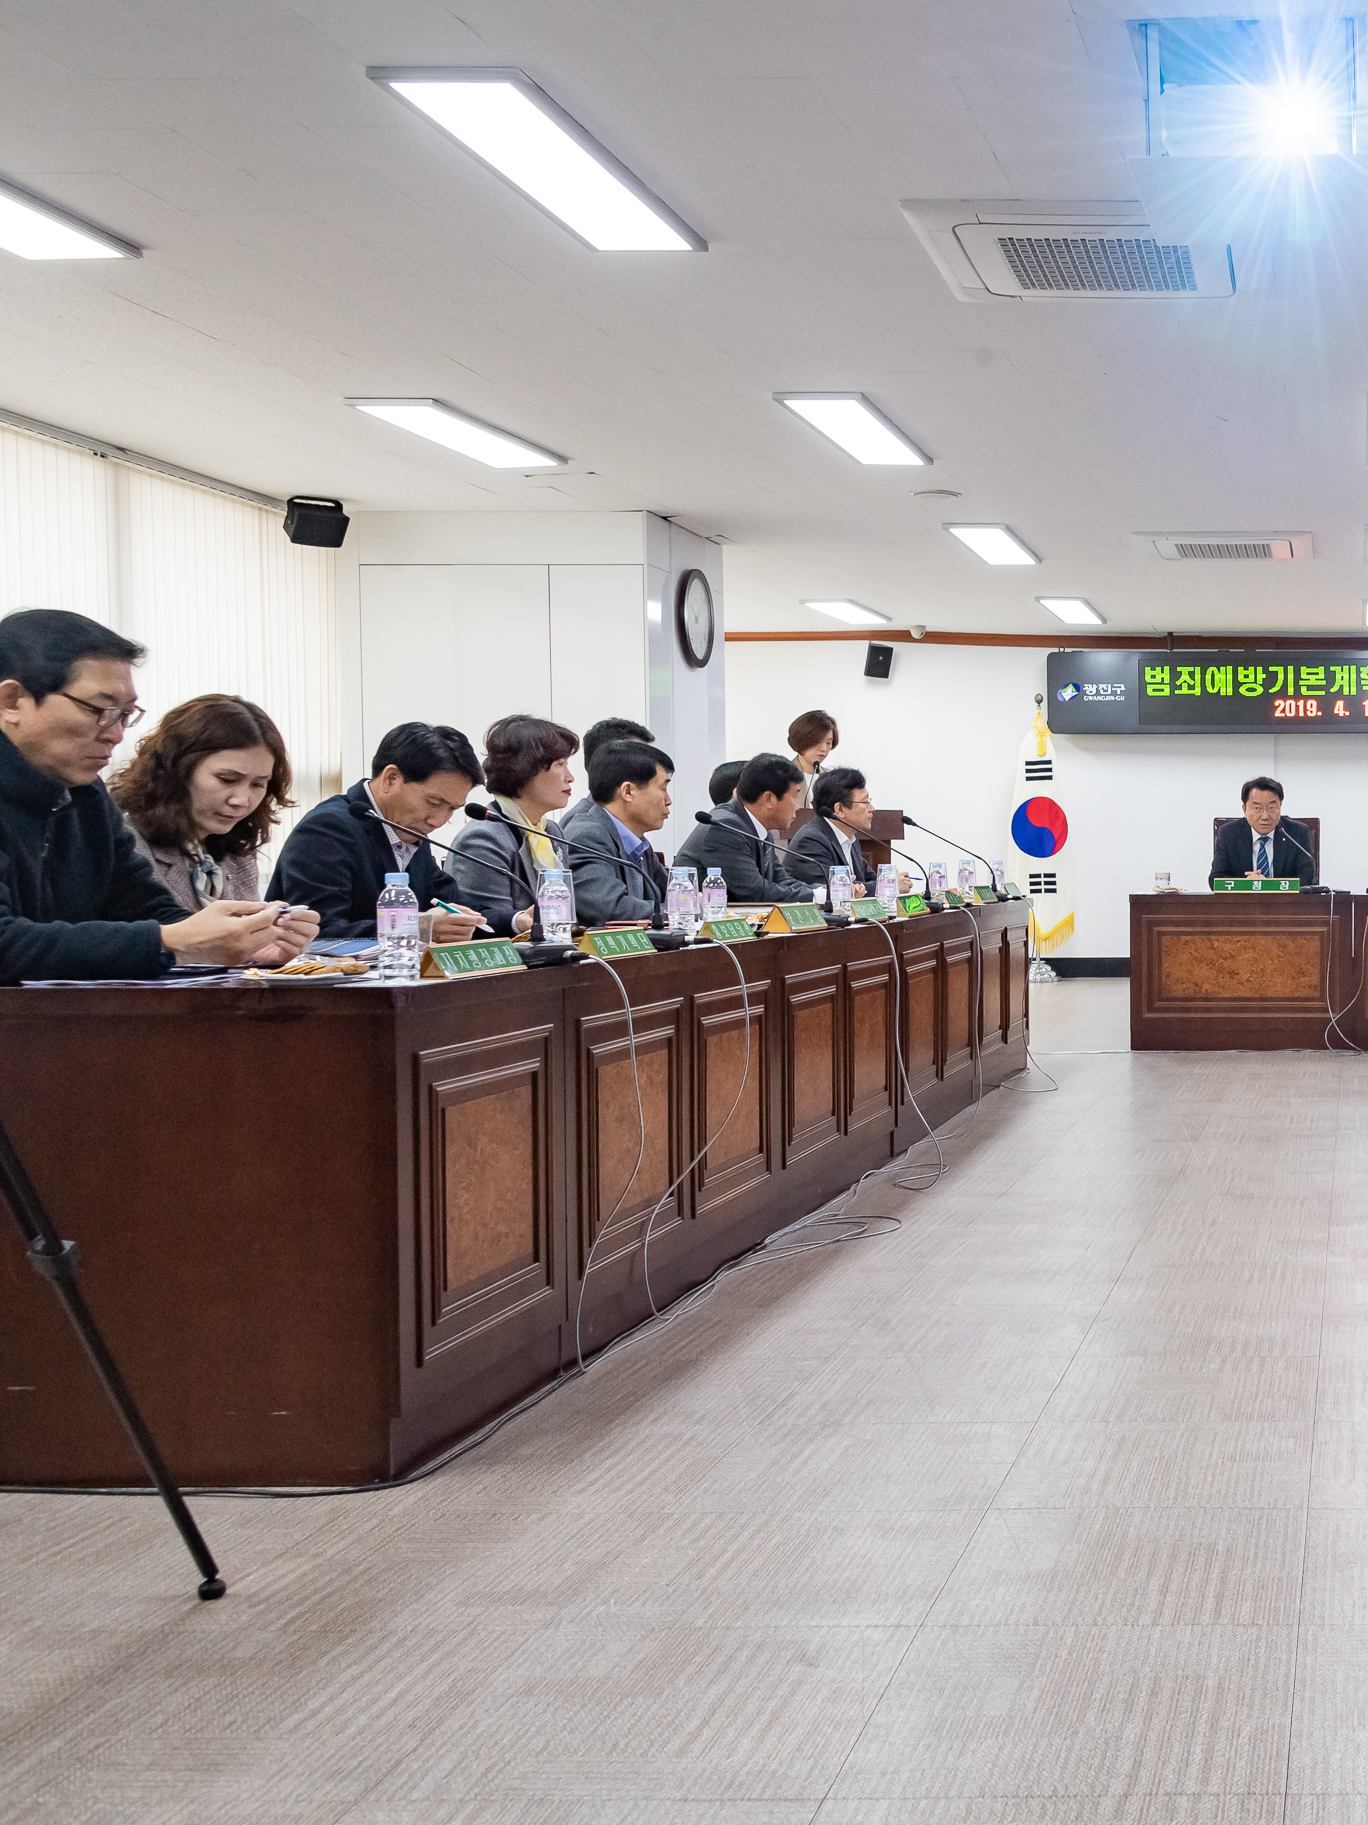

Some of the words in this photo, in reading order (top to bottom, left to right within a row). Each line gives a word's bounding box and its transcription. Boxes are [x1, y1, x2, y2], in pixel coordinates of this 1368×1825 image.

[1082, 683, 1126, 695] 광진구
[1274, 699, 1323, 717] 2019.
[1333, 699, 1350, 717] 4.
[593, 932, 651, 954] 정책기획단
[440, 946, 517, 972] 자치행정과장
